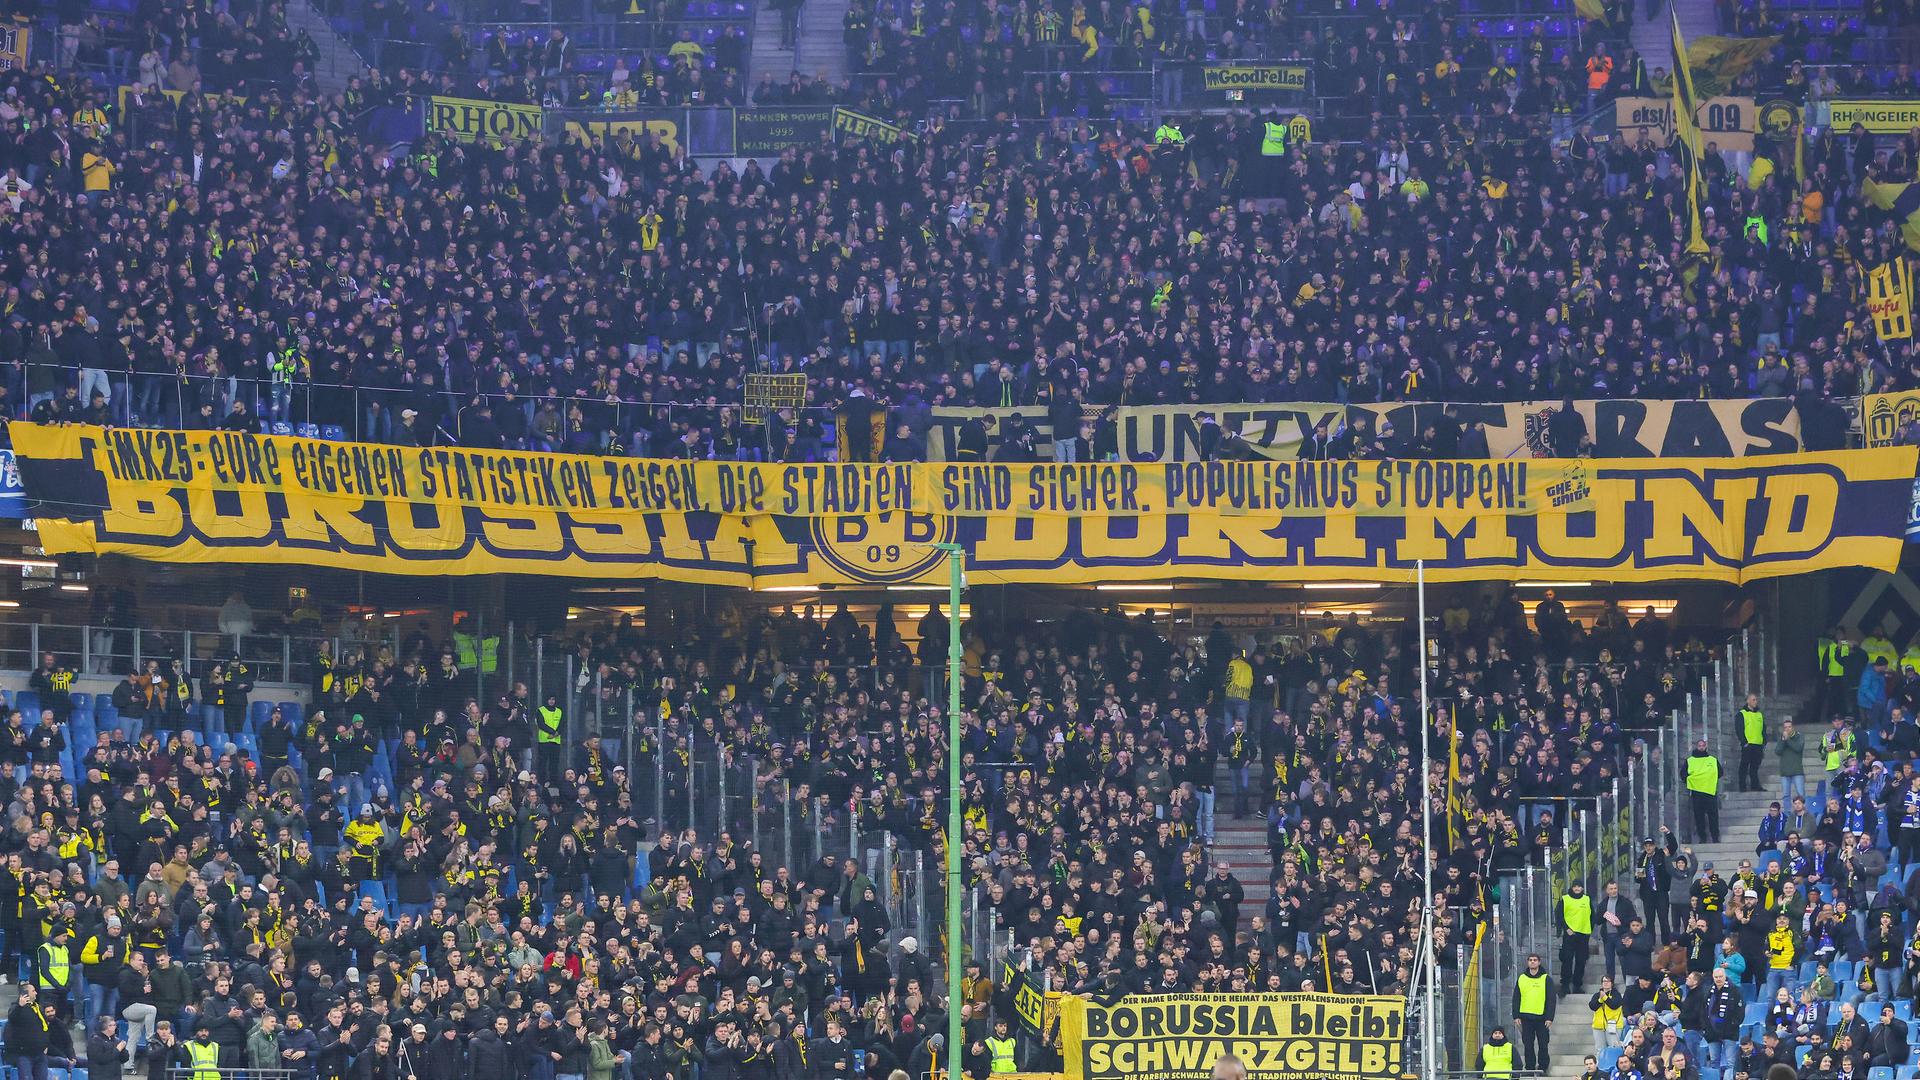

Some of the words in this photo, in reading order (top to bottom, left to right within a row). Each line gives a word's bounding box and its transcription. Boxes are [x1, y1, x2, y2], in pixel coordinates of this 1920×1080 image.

[1219, 69, 1305, 85] GoodFellas
[434, 103, 542, 139] RHÖN
[791, 112, 829, 122] POWER
[1708, 103, 1741, 132] 09
[1832, 108, 1919, 122] RHÖNGEIER
[769, 127, 794, 136] 1995
[866, 545, 900, 563] 09
[1122, 997, 1139, 1005] DER
[1141, 995, 1165, 1004] NAME
[1167, 994, 1210, 1002] BORUSSIA!
[1280, 995, 1366, 1004] WESTFALENSTADION!
[1087, 1004, 1278, 1038] BORUSSIA
[1291, 1003, 1401, 1038] bleibt
[1089, 1040, 1401, 1075] SCHWARZGELB!
